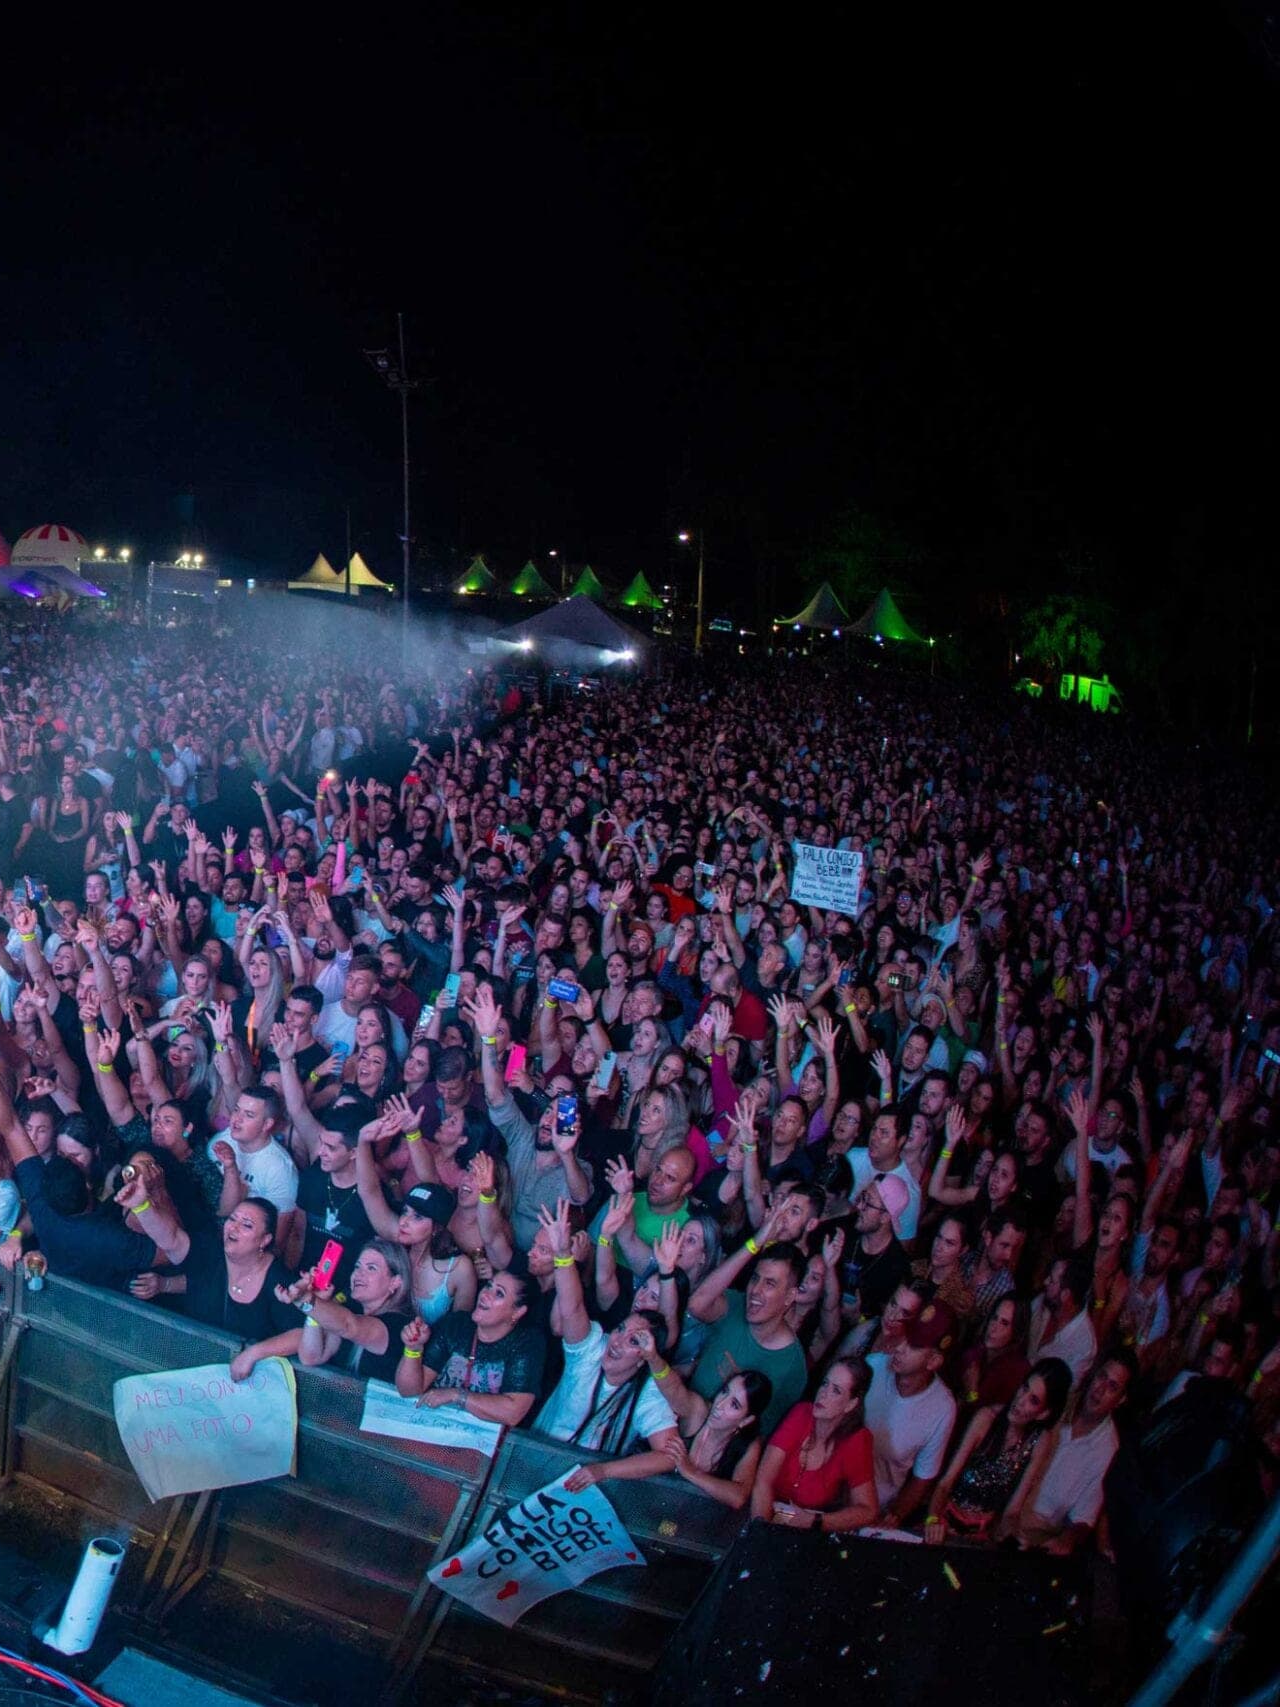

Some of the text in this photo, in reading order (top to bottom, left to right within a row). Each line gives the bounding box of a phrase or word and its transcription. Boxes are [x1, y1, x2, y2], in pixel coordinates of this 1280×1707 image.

[802, 846, 859, 868] FALA COMIGO
[135, 1373, 267, 1411] MEU SONHO
[132, 1412, 254, 1456] UMA FOTO
[483, 1491, 567, 1549] FALA
[477, 1507, 595, 1580] COMIGO
